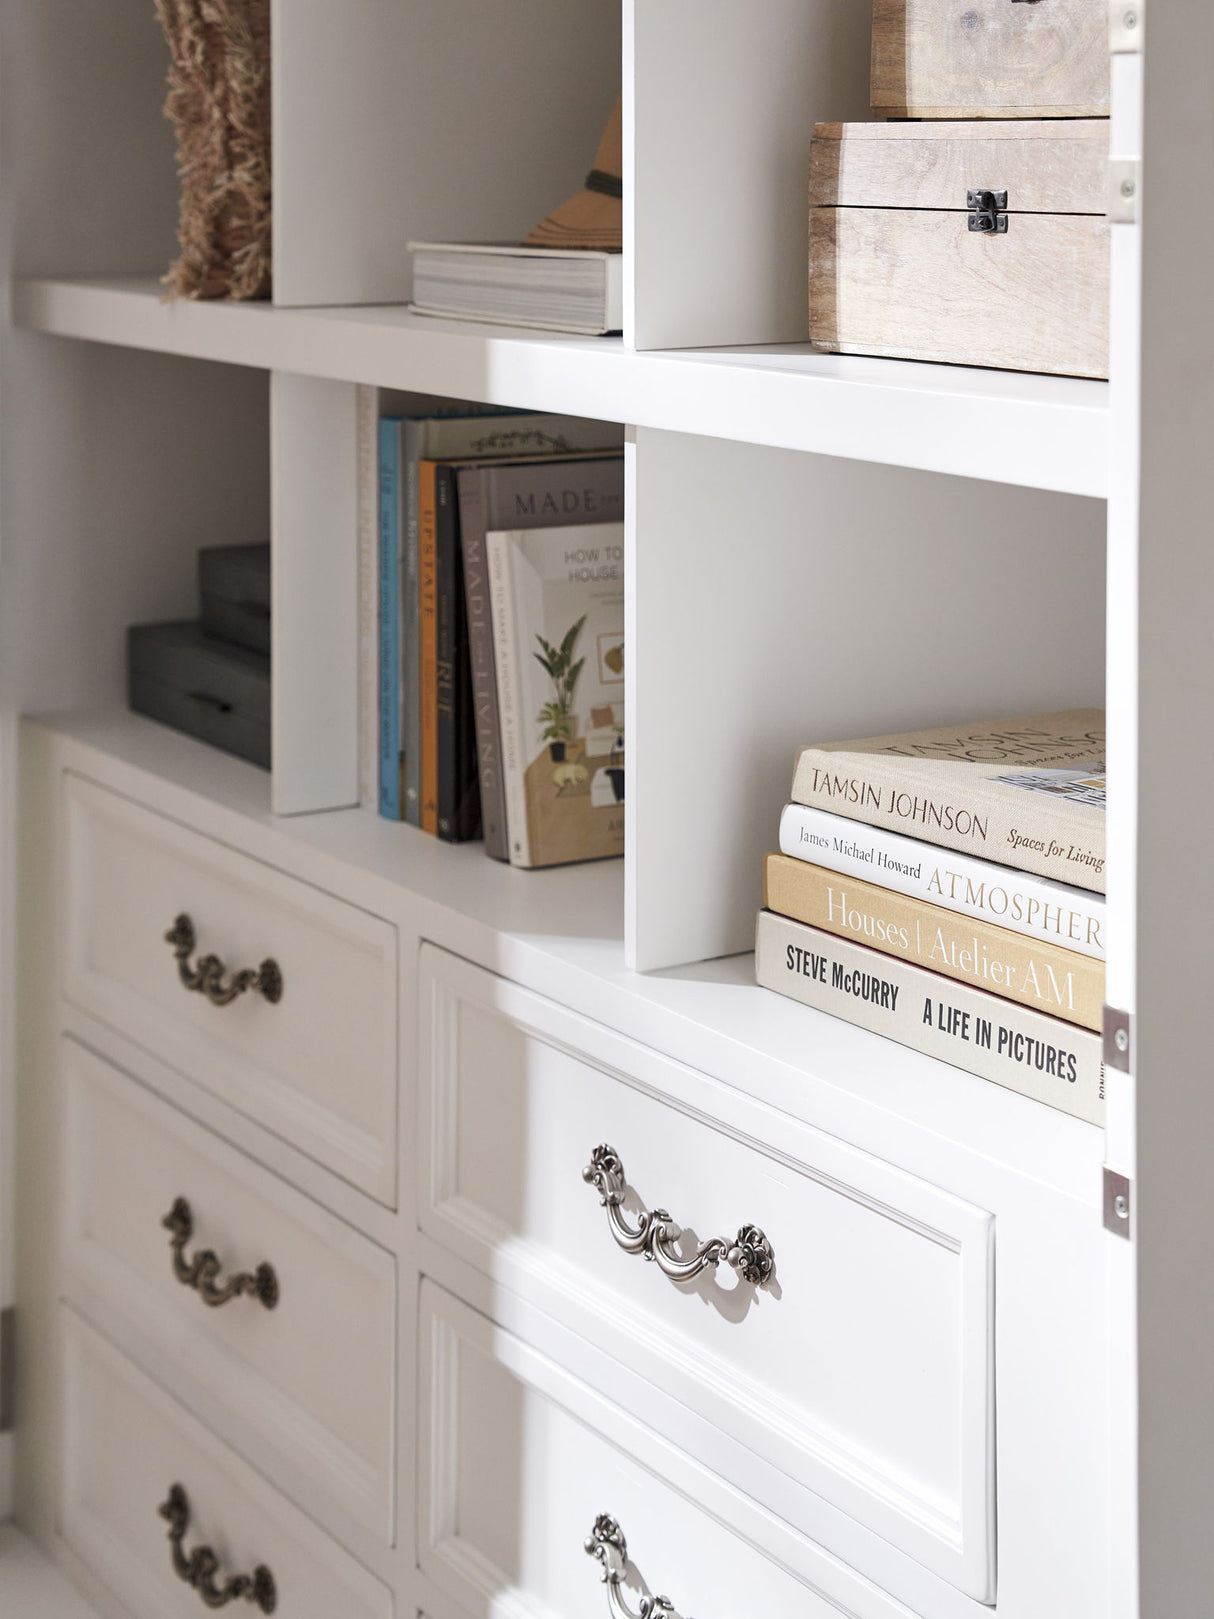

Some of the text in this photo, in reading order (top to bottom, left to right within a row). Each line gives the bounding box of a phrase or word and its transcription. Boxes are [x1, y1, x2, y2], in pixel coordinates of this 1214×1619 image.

[515, 489, 598, 516] MADE
[424, 509, 435, 618] UPSTATE
[565, 546, 623, 564] HOW TO
[568, 565, 619, 582] HOUSE
[467, 540, 486, 635] MADE
[477, 672, 496, 788] LIVING
[885, 728, 1052, 757] TAMSIN
[799, 827, 830, 849] James
[832, 837, 874, 864] Michael
[877, 851, 921, 880] Howard
[812, 767, 1105, 872] TAMSIN JOHNSON Spaces for Living
[826, 888, 909, 949] Houses
[928, 928, 1016, 988] Atelier
[1020, 959, 1076, 1011] AM
[786, 945, 1078, 1084] STEVE McCURRY A LIFE IN PICTURES
